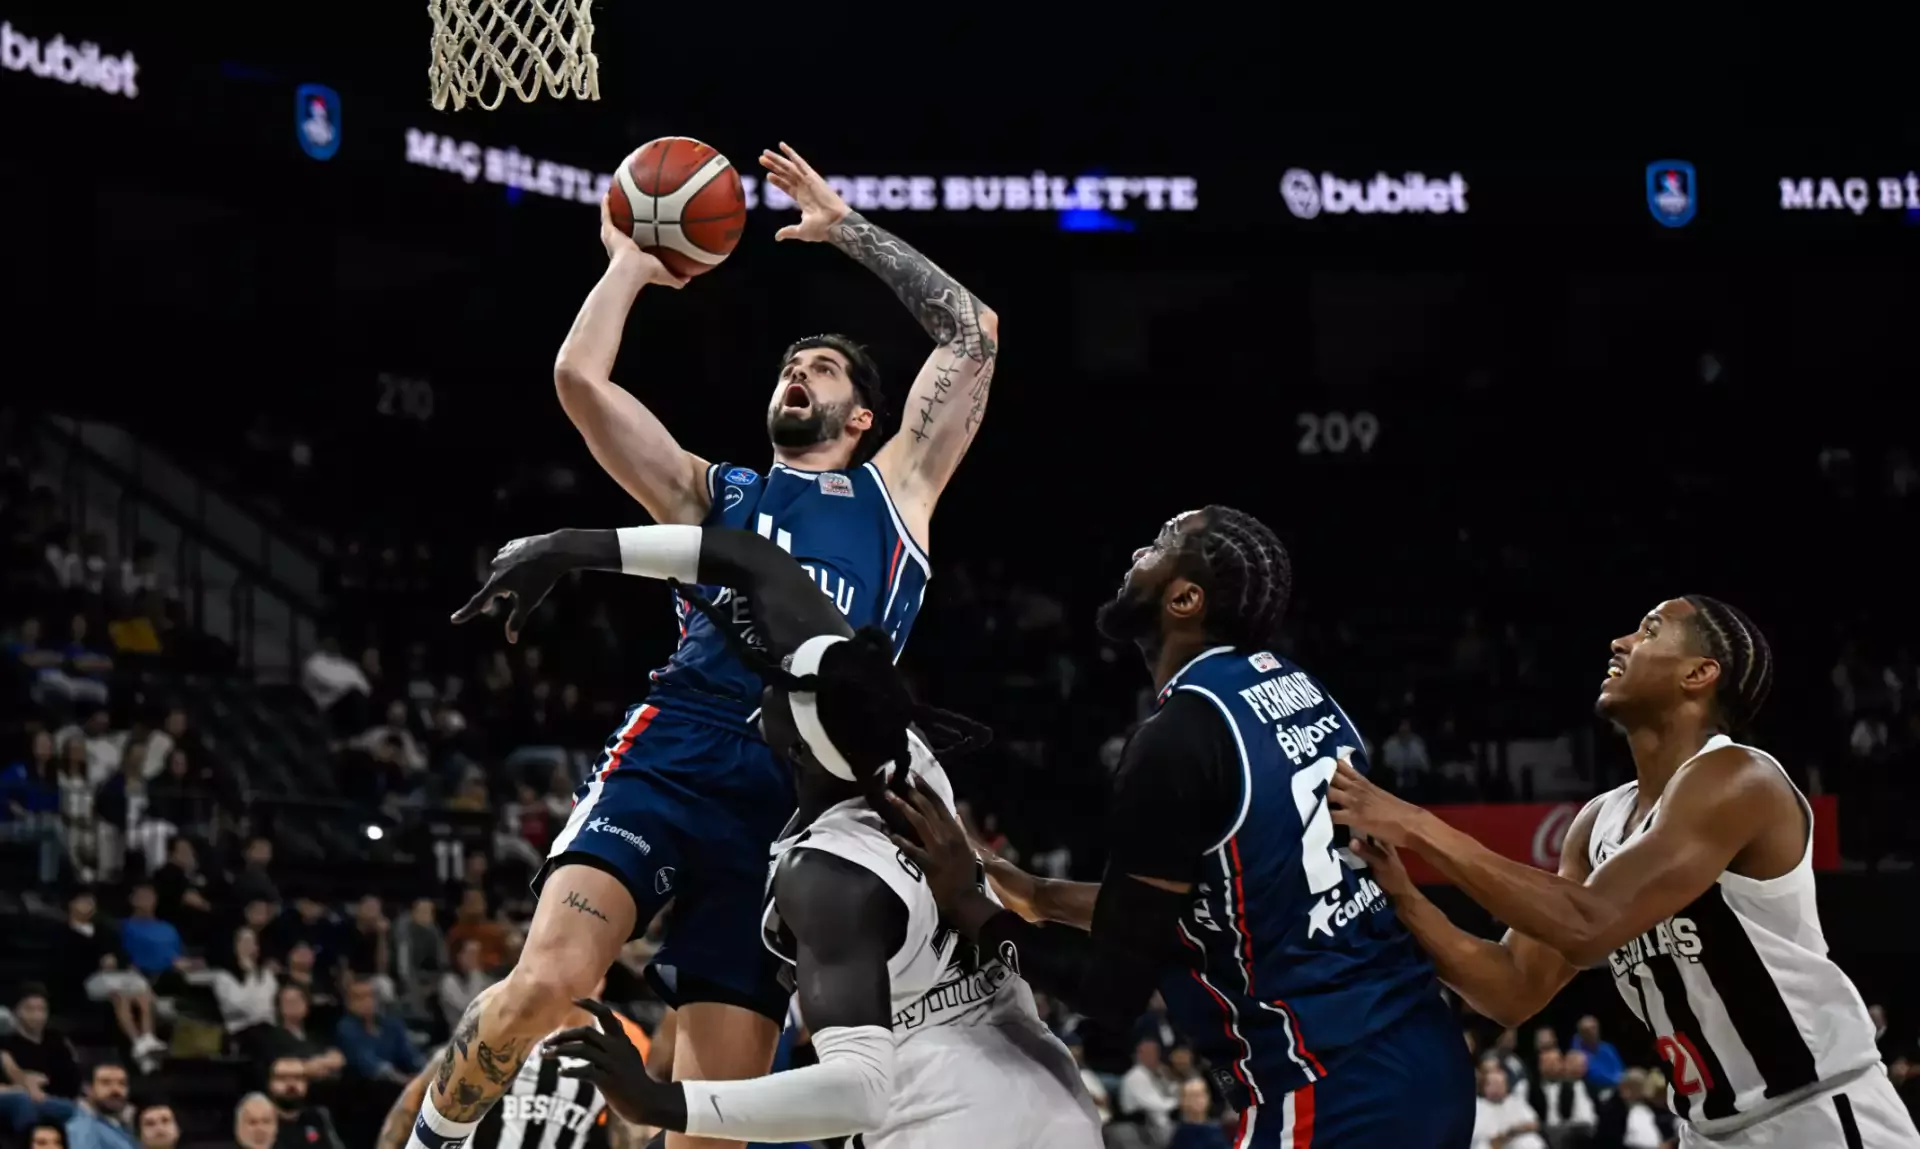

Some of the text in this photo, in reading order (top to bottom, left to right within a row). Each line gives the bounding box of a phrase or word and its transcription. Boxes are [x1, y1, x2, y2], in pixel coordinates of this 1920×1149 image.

[1, 20, 140, 99] bubilet
[405, 127, 481, 183] MAÇ
[1321, 170, 1470, 214] bubilet
[1779, 177, 1870, 215] MAÇ
[1297, 411, 1380, 453] 209
[602, 823, 652, 855] corendon
[1657, 1031, 1714, 1095] 21
